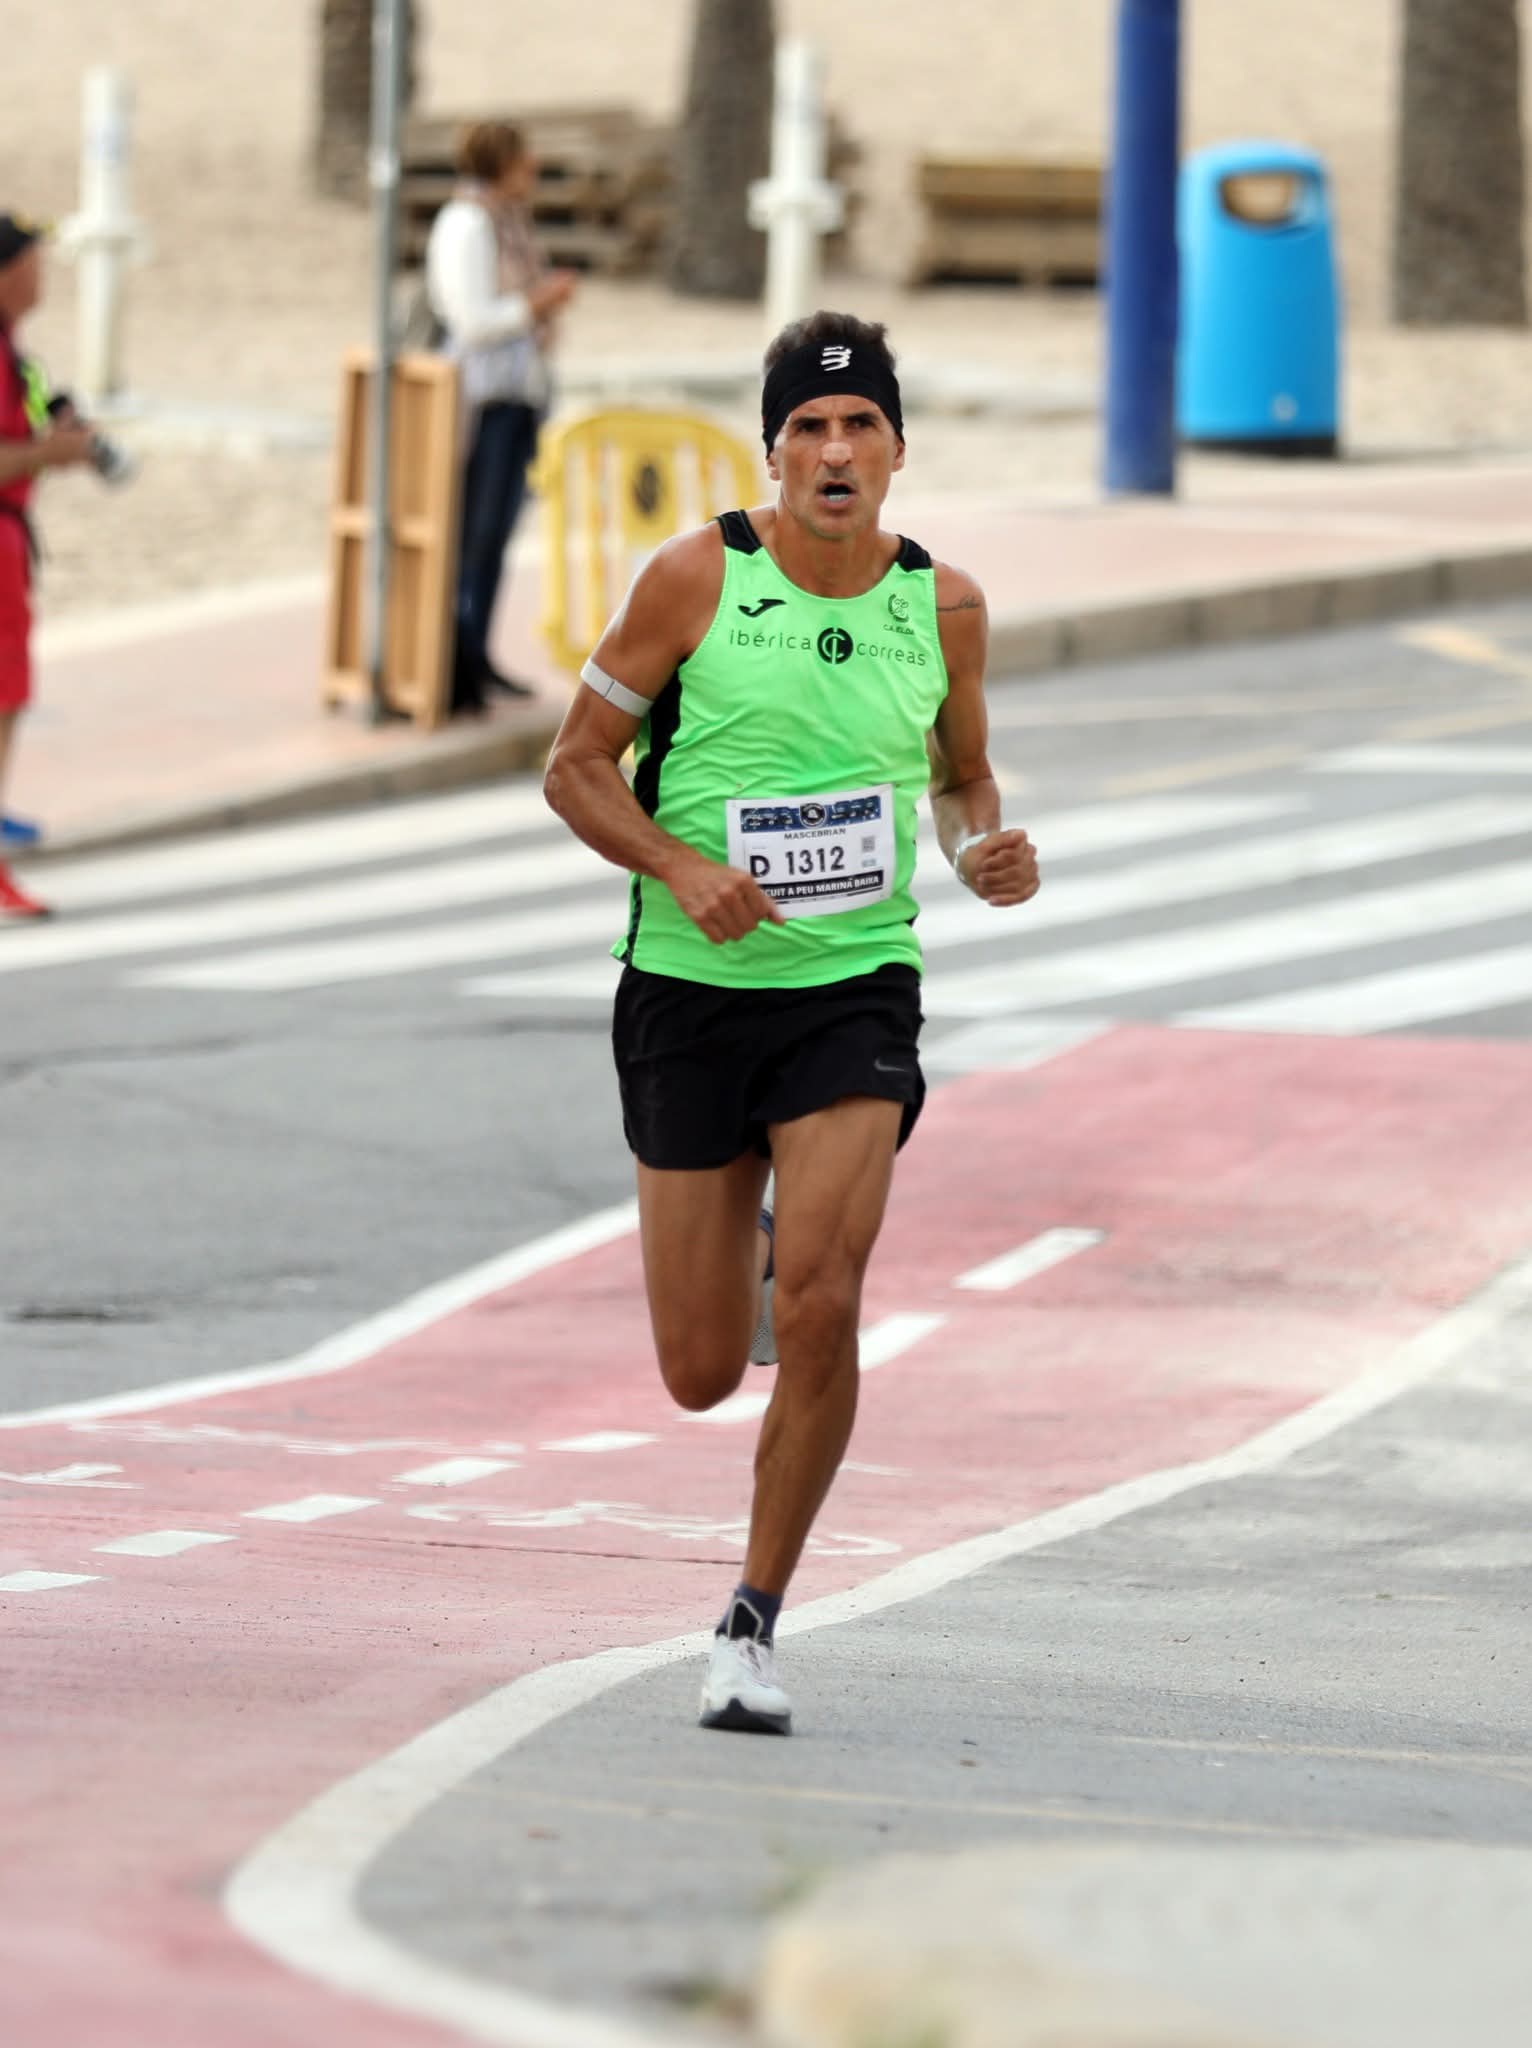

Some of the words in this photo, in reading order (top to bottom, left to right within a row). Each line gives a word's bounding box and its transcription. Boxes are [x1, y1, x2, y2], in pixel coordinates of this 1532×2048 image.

[729, 629, 812, 651] ibérica
[856, 642, 927, 667] correas
[783, 827, 846, 841] MASCEBRIAN
[749, 855, 771, 878] D
[785, 845, 845, 875] 1312
[787, 887, 795, 896] A
[796, 885, 814, 895] PEU
